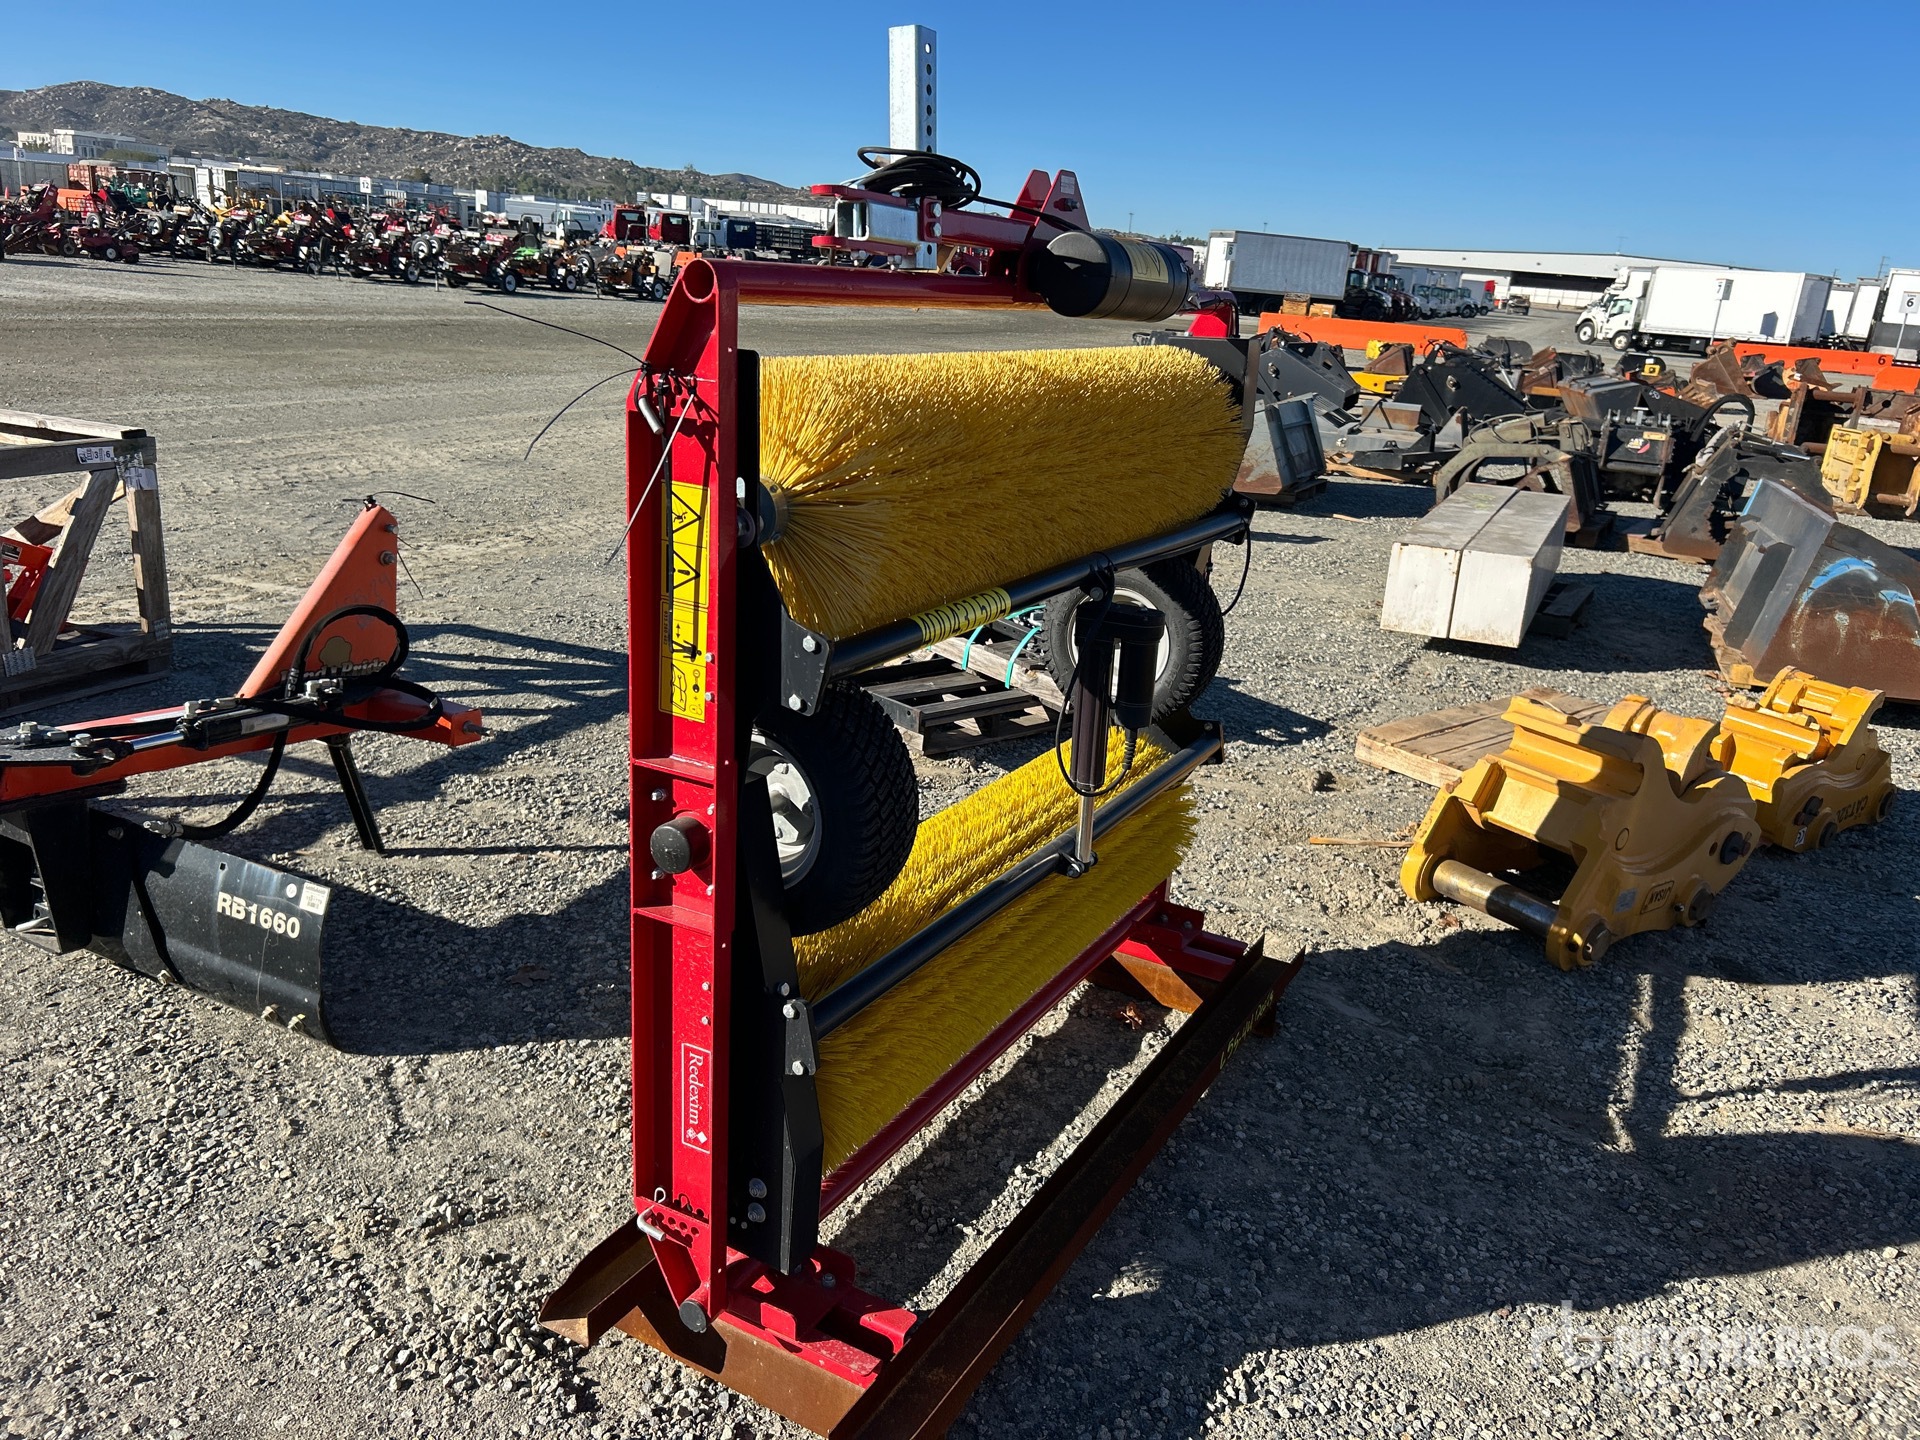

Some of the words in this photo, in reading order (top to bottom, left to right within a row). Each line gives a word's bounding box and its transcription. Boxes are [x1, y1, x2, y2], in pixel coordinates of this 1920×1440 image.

[362, 181, 370, 189] 12
[1906, 298, 1914, 308] 6
[1878, 356, 1886, 366] 6
[216, 891, 301, 938] RB1660
[688, 1051, 705, 1125] Redexim
